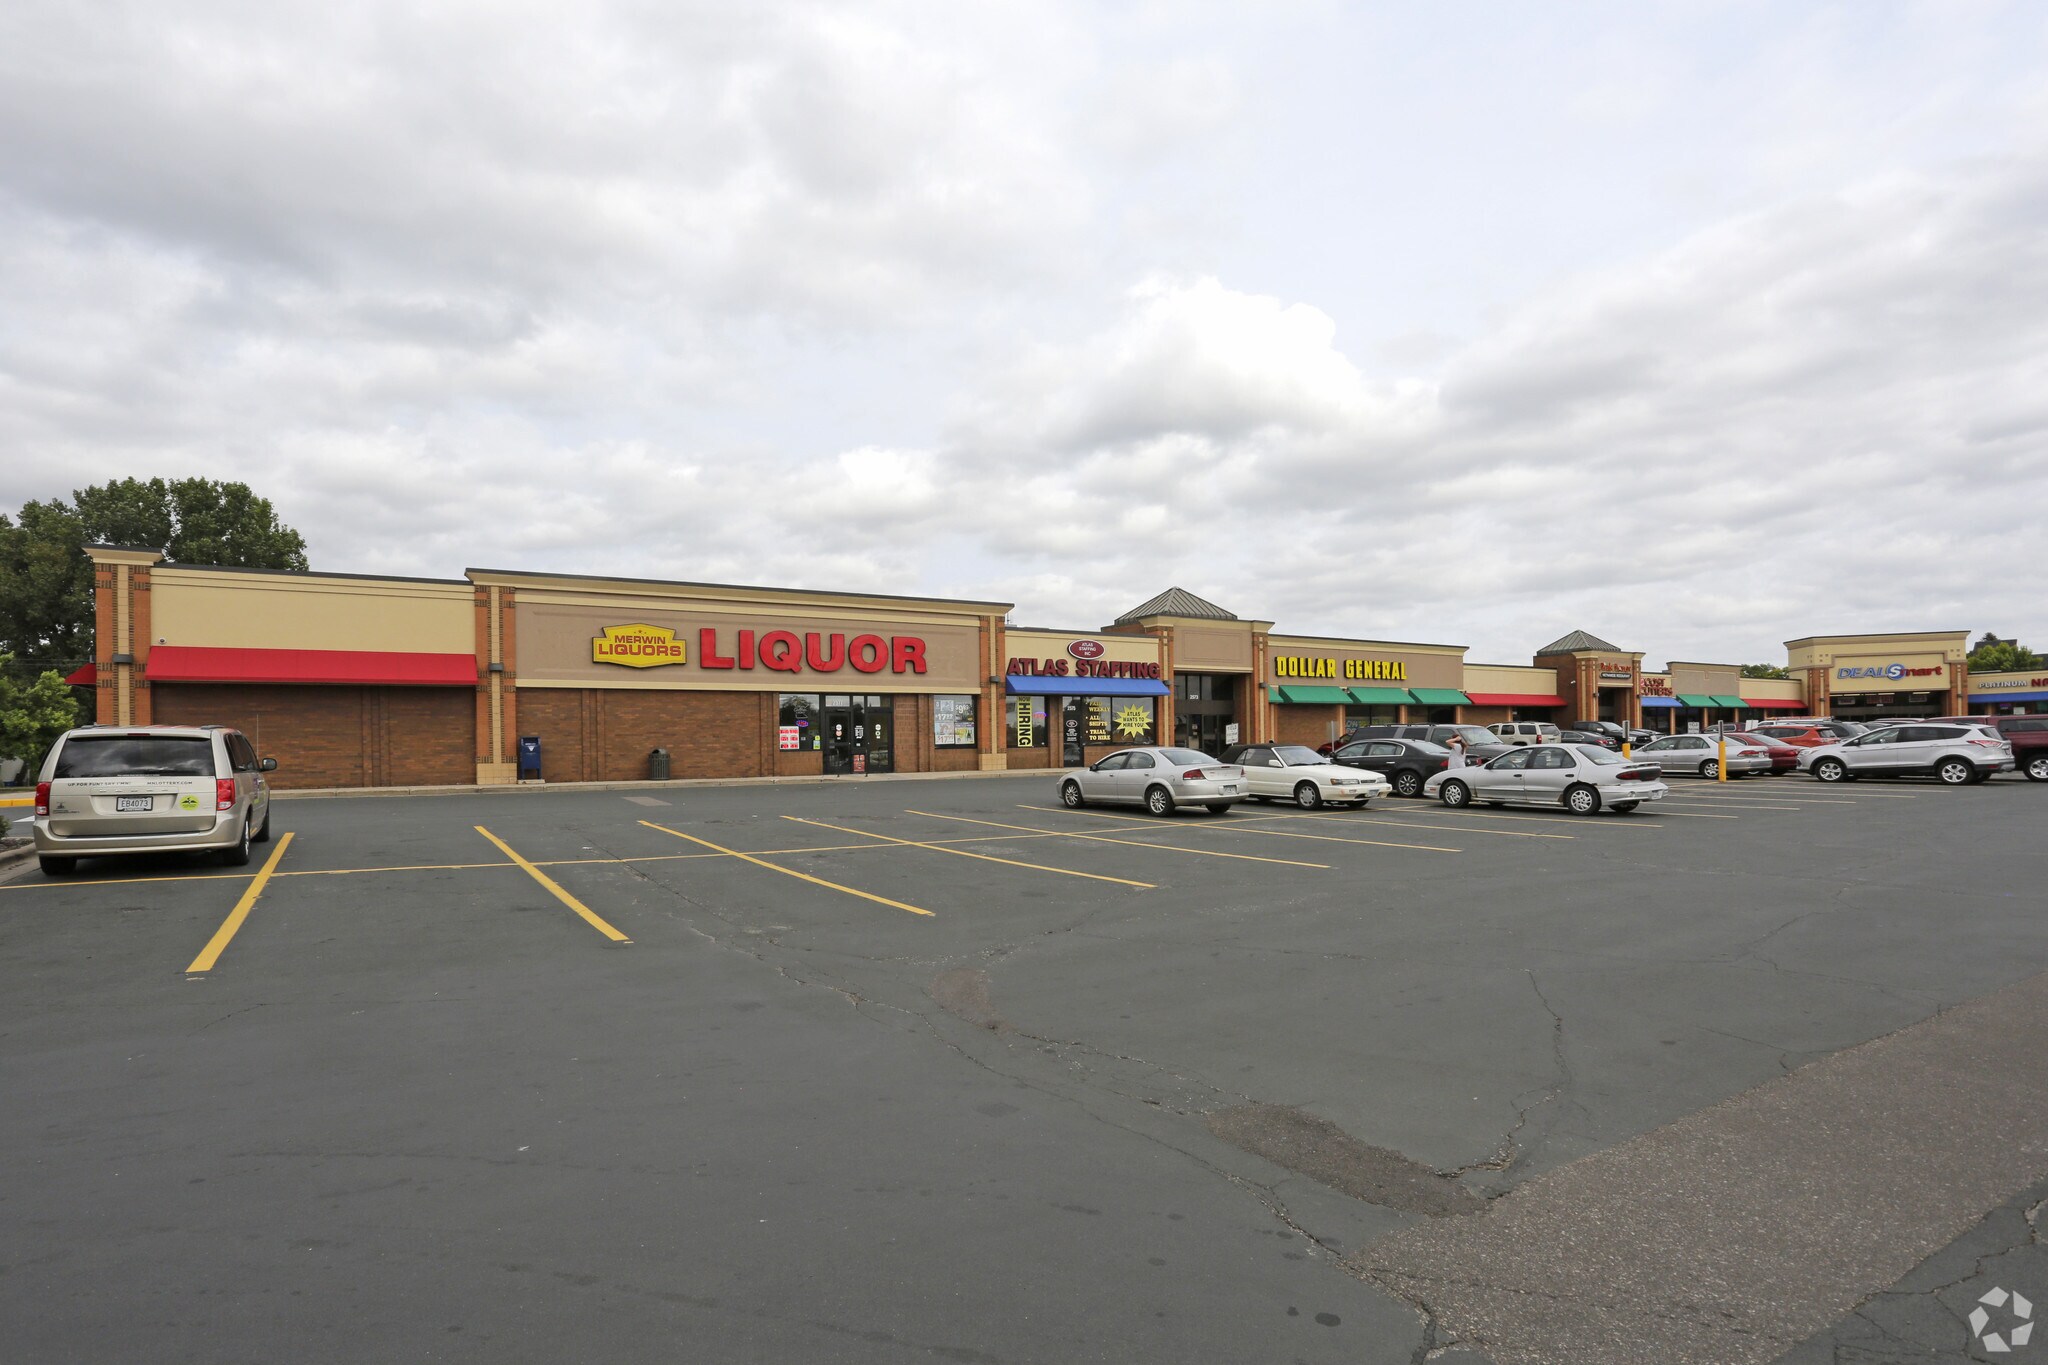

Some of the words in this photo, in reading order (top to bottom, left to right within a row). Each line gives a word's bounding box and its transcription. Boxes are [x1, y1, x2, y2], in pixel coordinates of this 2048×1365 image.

[614, 635, 666, 645] MERWIN
[598, 643, 682, 657] LIQUORS
[700, 627, 927, 674] LIQUOR
[1007, 657, 1069, 676] ATLAS
[1075, 659, 1160, 679] STAFFING
[1276, 656, 1336, 678] DOLLAR
[1345, 659, 1407, 680] GENERAL
[1978, 680, 2027, 689] PLATINUM
[1018, 702, 1031, 746] HIRING
[121, 800, 149, 808] EB4073
